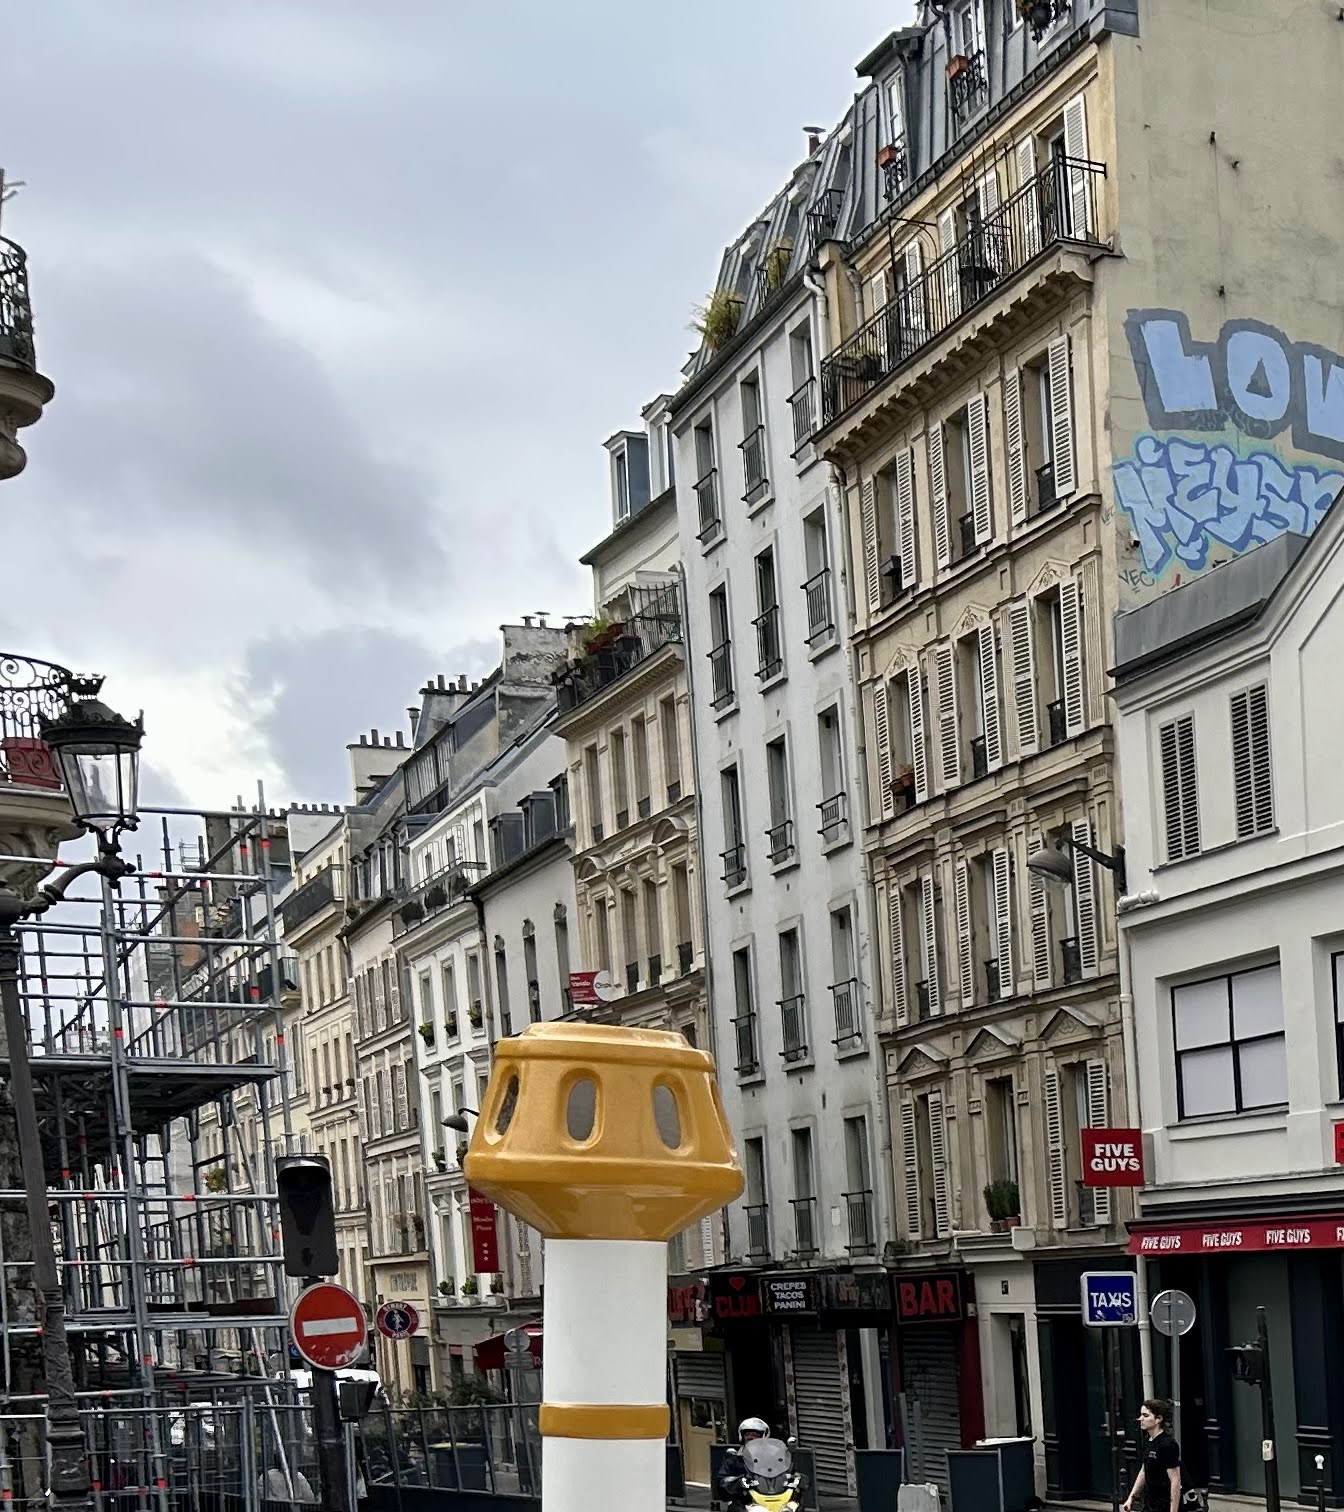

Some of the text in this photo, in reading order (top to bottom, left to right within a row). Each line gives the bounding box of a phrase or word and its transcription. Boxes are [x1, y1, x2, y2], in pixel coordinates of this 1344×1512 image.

[1095, 1143, 1135, 1158] FIVE
[1091, 1157, 1141, 1172] GUYS
[1141, 1235, 1181, 1250] FIVE GUYS
[1202, 1231, 1243, 1247] FIVE GUYS
[1266, 1228, 1311, 1244] FIVE GUYS
[774, 1291, 804, 1300] TACOS
[902, 1280, 956, 1317] BAR
[1090, 1292, 1132, 1309] TAXIS
[774, 1301, 806, 1310] PANINI
